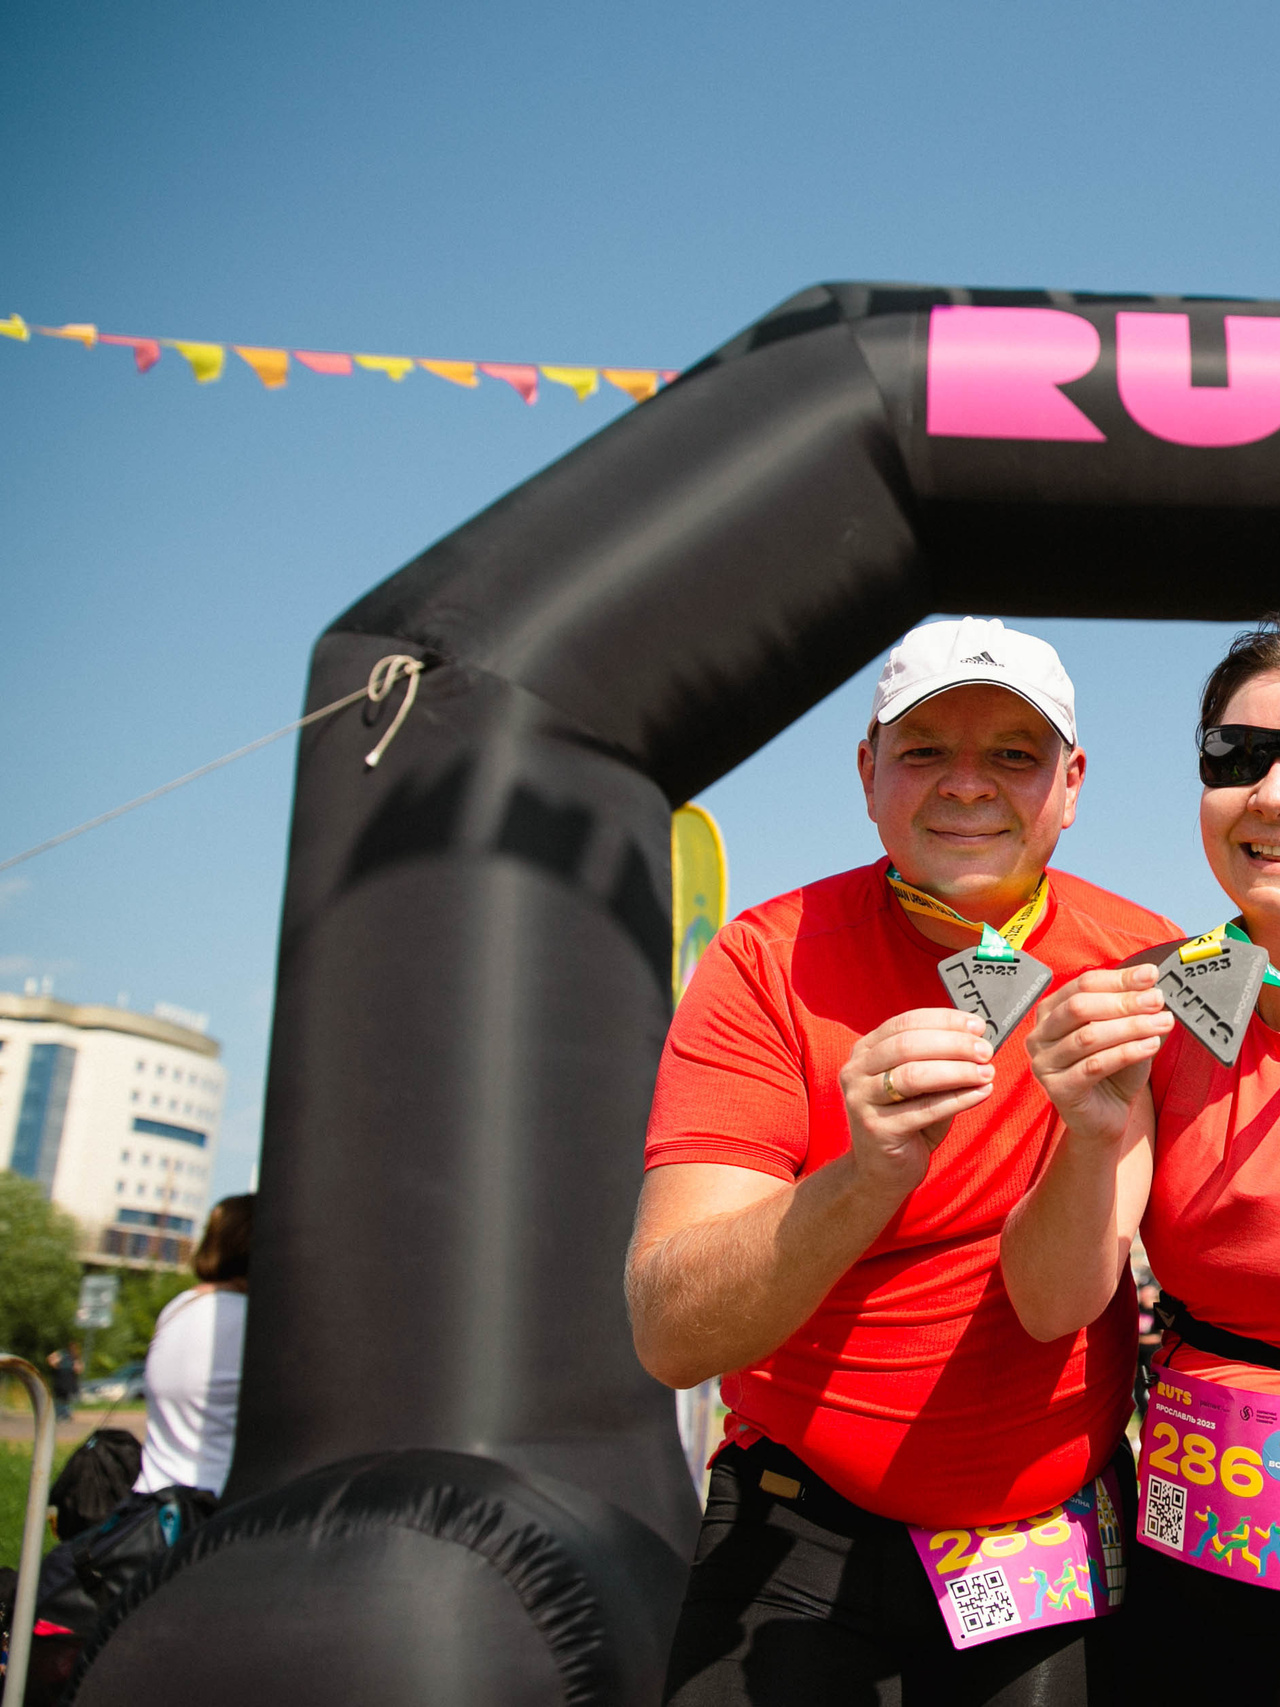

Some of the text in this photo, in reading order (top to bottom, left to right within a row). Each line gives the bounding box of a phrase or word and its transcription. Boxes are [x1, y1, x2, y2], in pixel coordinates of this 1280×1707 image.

[960, 658, 1005, 668] adidas
[972, 963, 1017, 975] 2023
[1184, 957, 1231, 978] 2023
[1001, 972, 1048, 1027] ЯРОСЛАВЛЬ
[1156, 1381, 1192, 1406] RUTS
[1155, 1403, 1196, 1424] ЯРОСЛАВЛЬ
[1196, 1417, 1216, 1430] 2023
[1149, 1422, 1264, 1498] 286
[1067, 1496, 1091, 1509] ОЛНА
[929, 1505, 1072, 1575] 288
